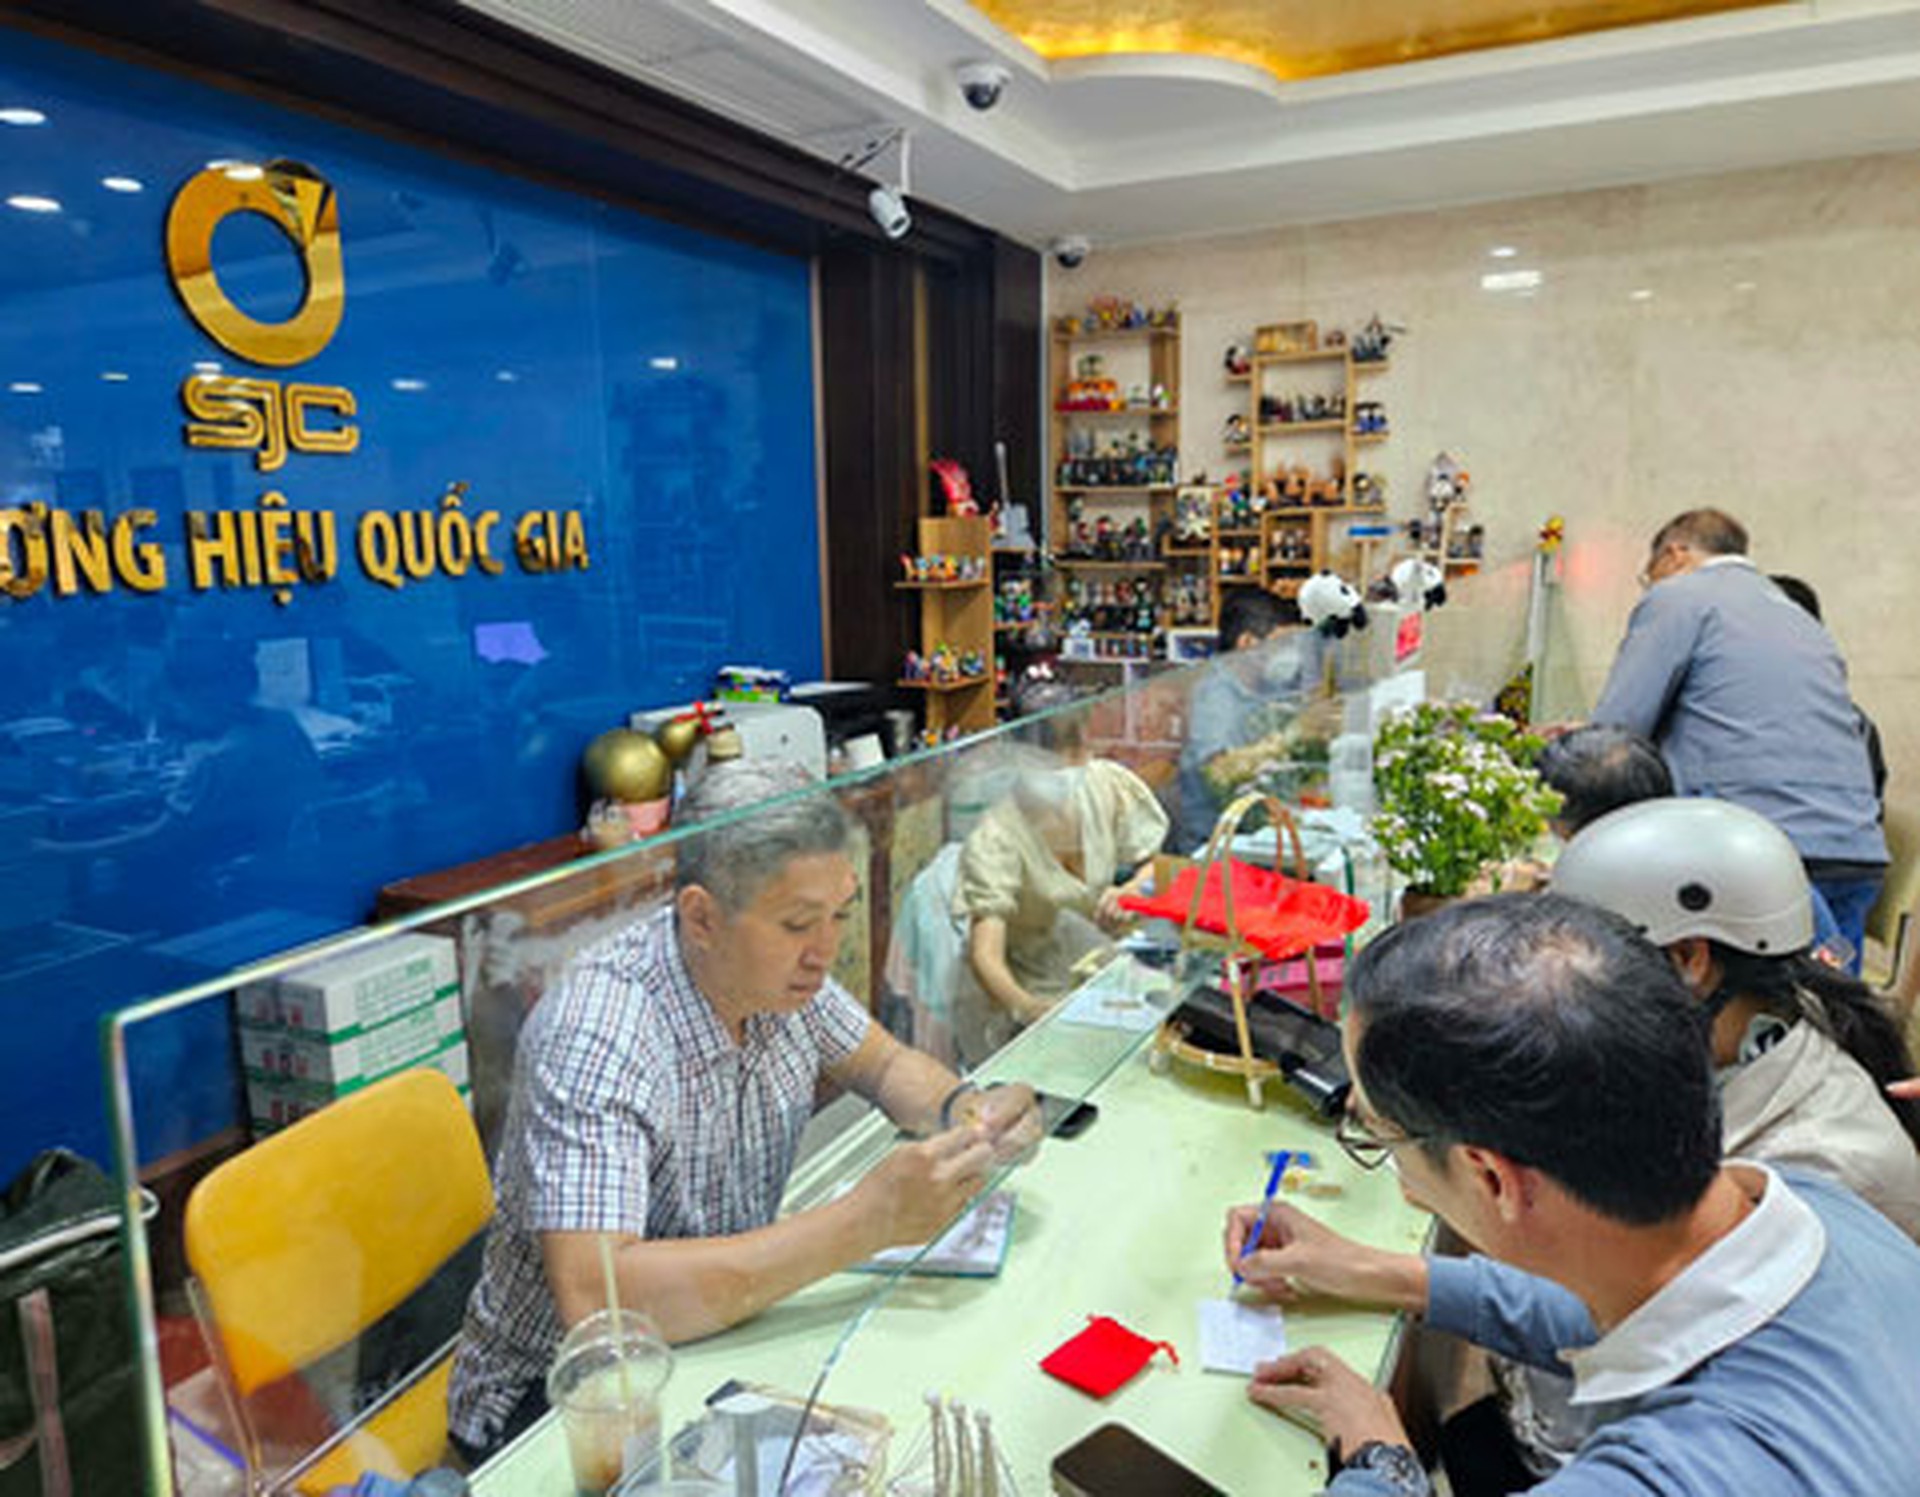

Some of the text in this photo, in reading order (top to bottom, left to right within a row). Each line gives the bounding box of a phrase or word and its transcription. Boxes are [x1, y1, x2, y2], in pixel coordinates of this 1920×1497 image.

[183, 374, 360, 472] SJC
[188, 490, 338, 605] HIỆU
[358, 481, 504, 587] QUỐC
[517, 509, 589, 571] GIA
